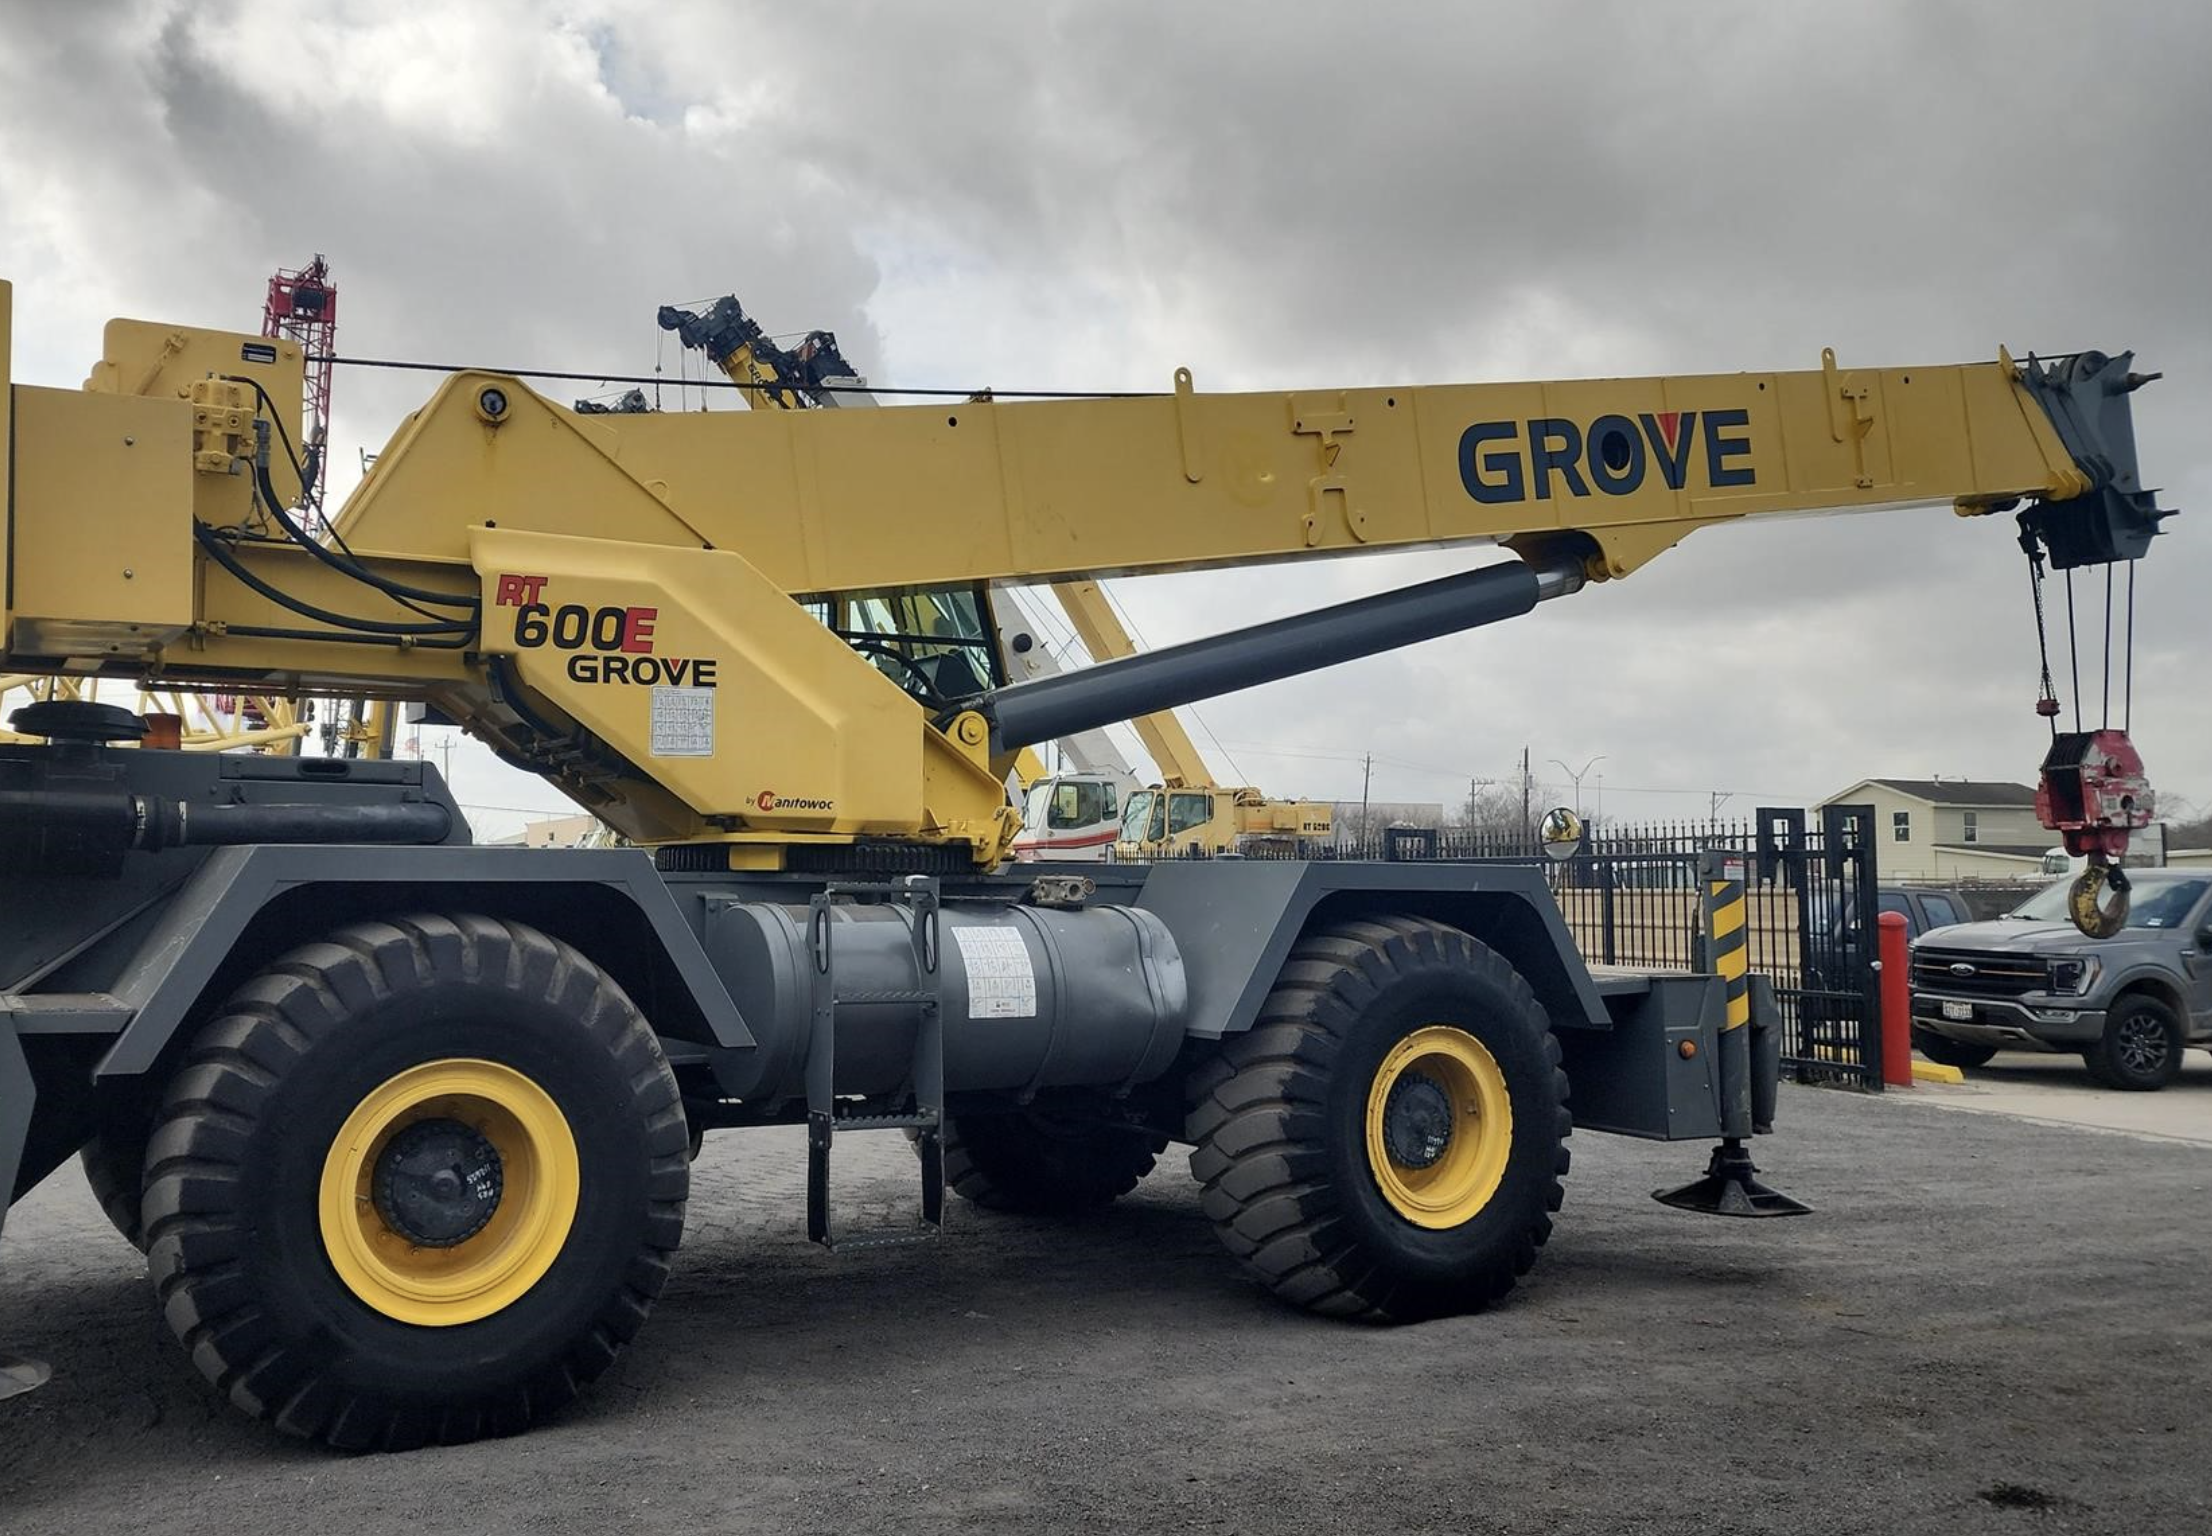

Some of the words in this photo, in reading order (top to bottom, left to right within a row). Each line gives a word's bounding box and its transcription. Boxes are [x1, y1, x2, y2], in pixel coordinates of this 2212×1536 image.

[1458, 409, 1757, 504] GROVE
[496, 574, 548, 607] RT
[514, 603, 658, 653] 600E
[567, 654, 717, 688] GROVE
[745, 796, 756, 807] by
[757, 790, 834, 812] Manitowoc
